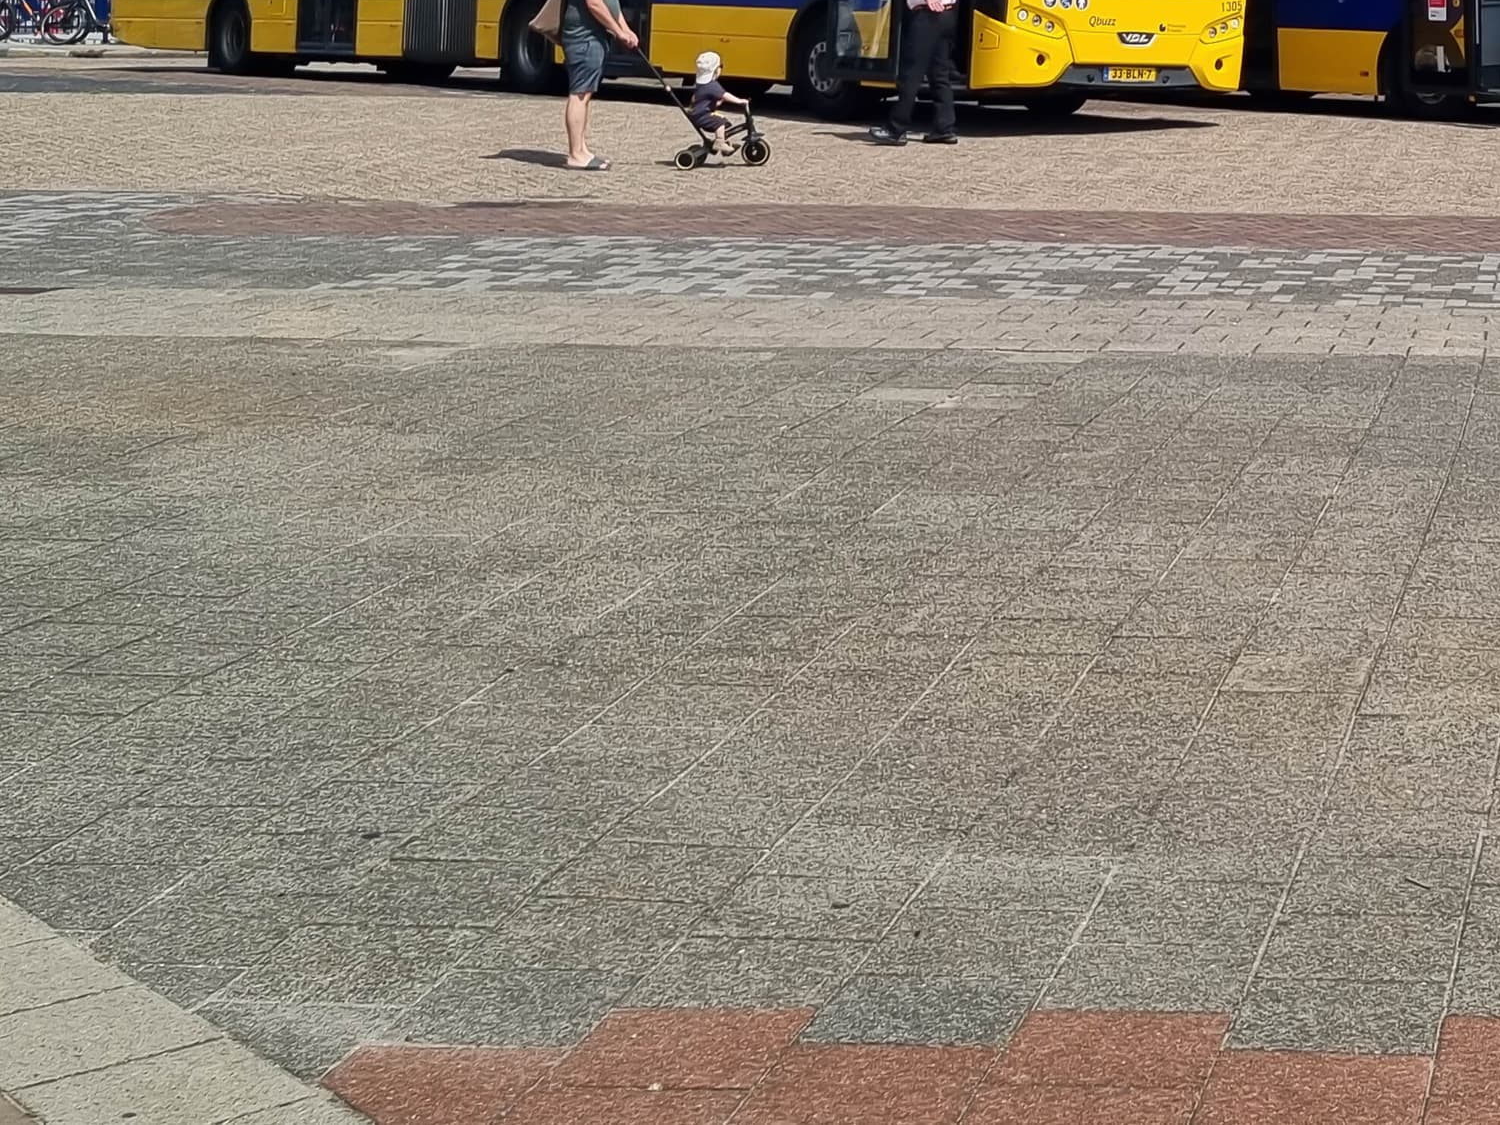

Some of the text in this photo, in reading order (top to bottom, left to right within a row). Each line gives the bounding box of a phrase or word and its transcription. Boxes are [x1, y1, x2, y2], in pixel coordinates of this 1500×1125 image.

[1221, 0, 1243, 13] 1305
[1088, 16, 1117, 27] Qbuzz
[1122, 33, 1150, 44] VDL
